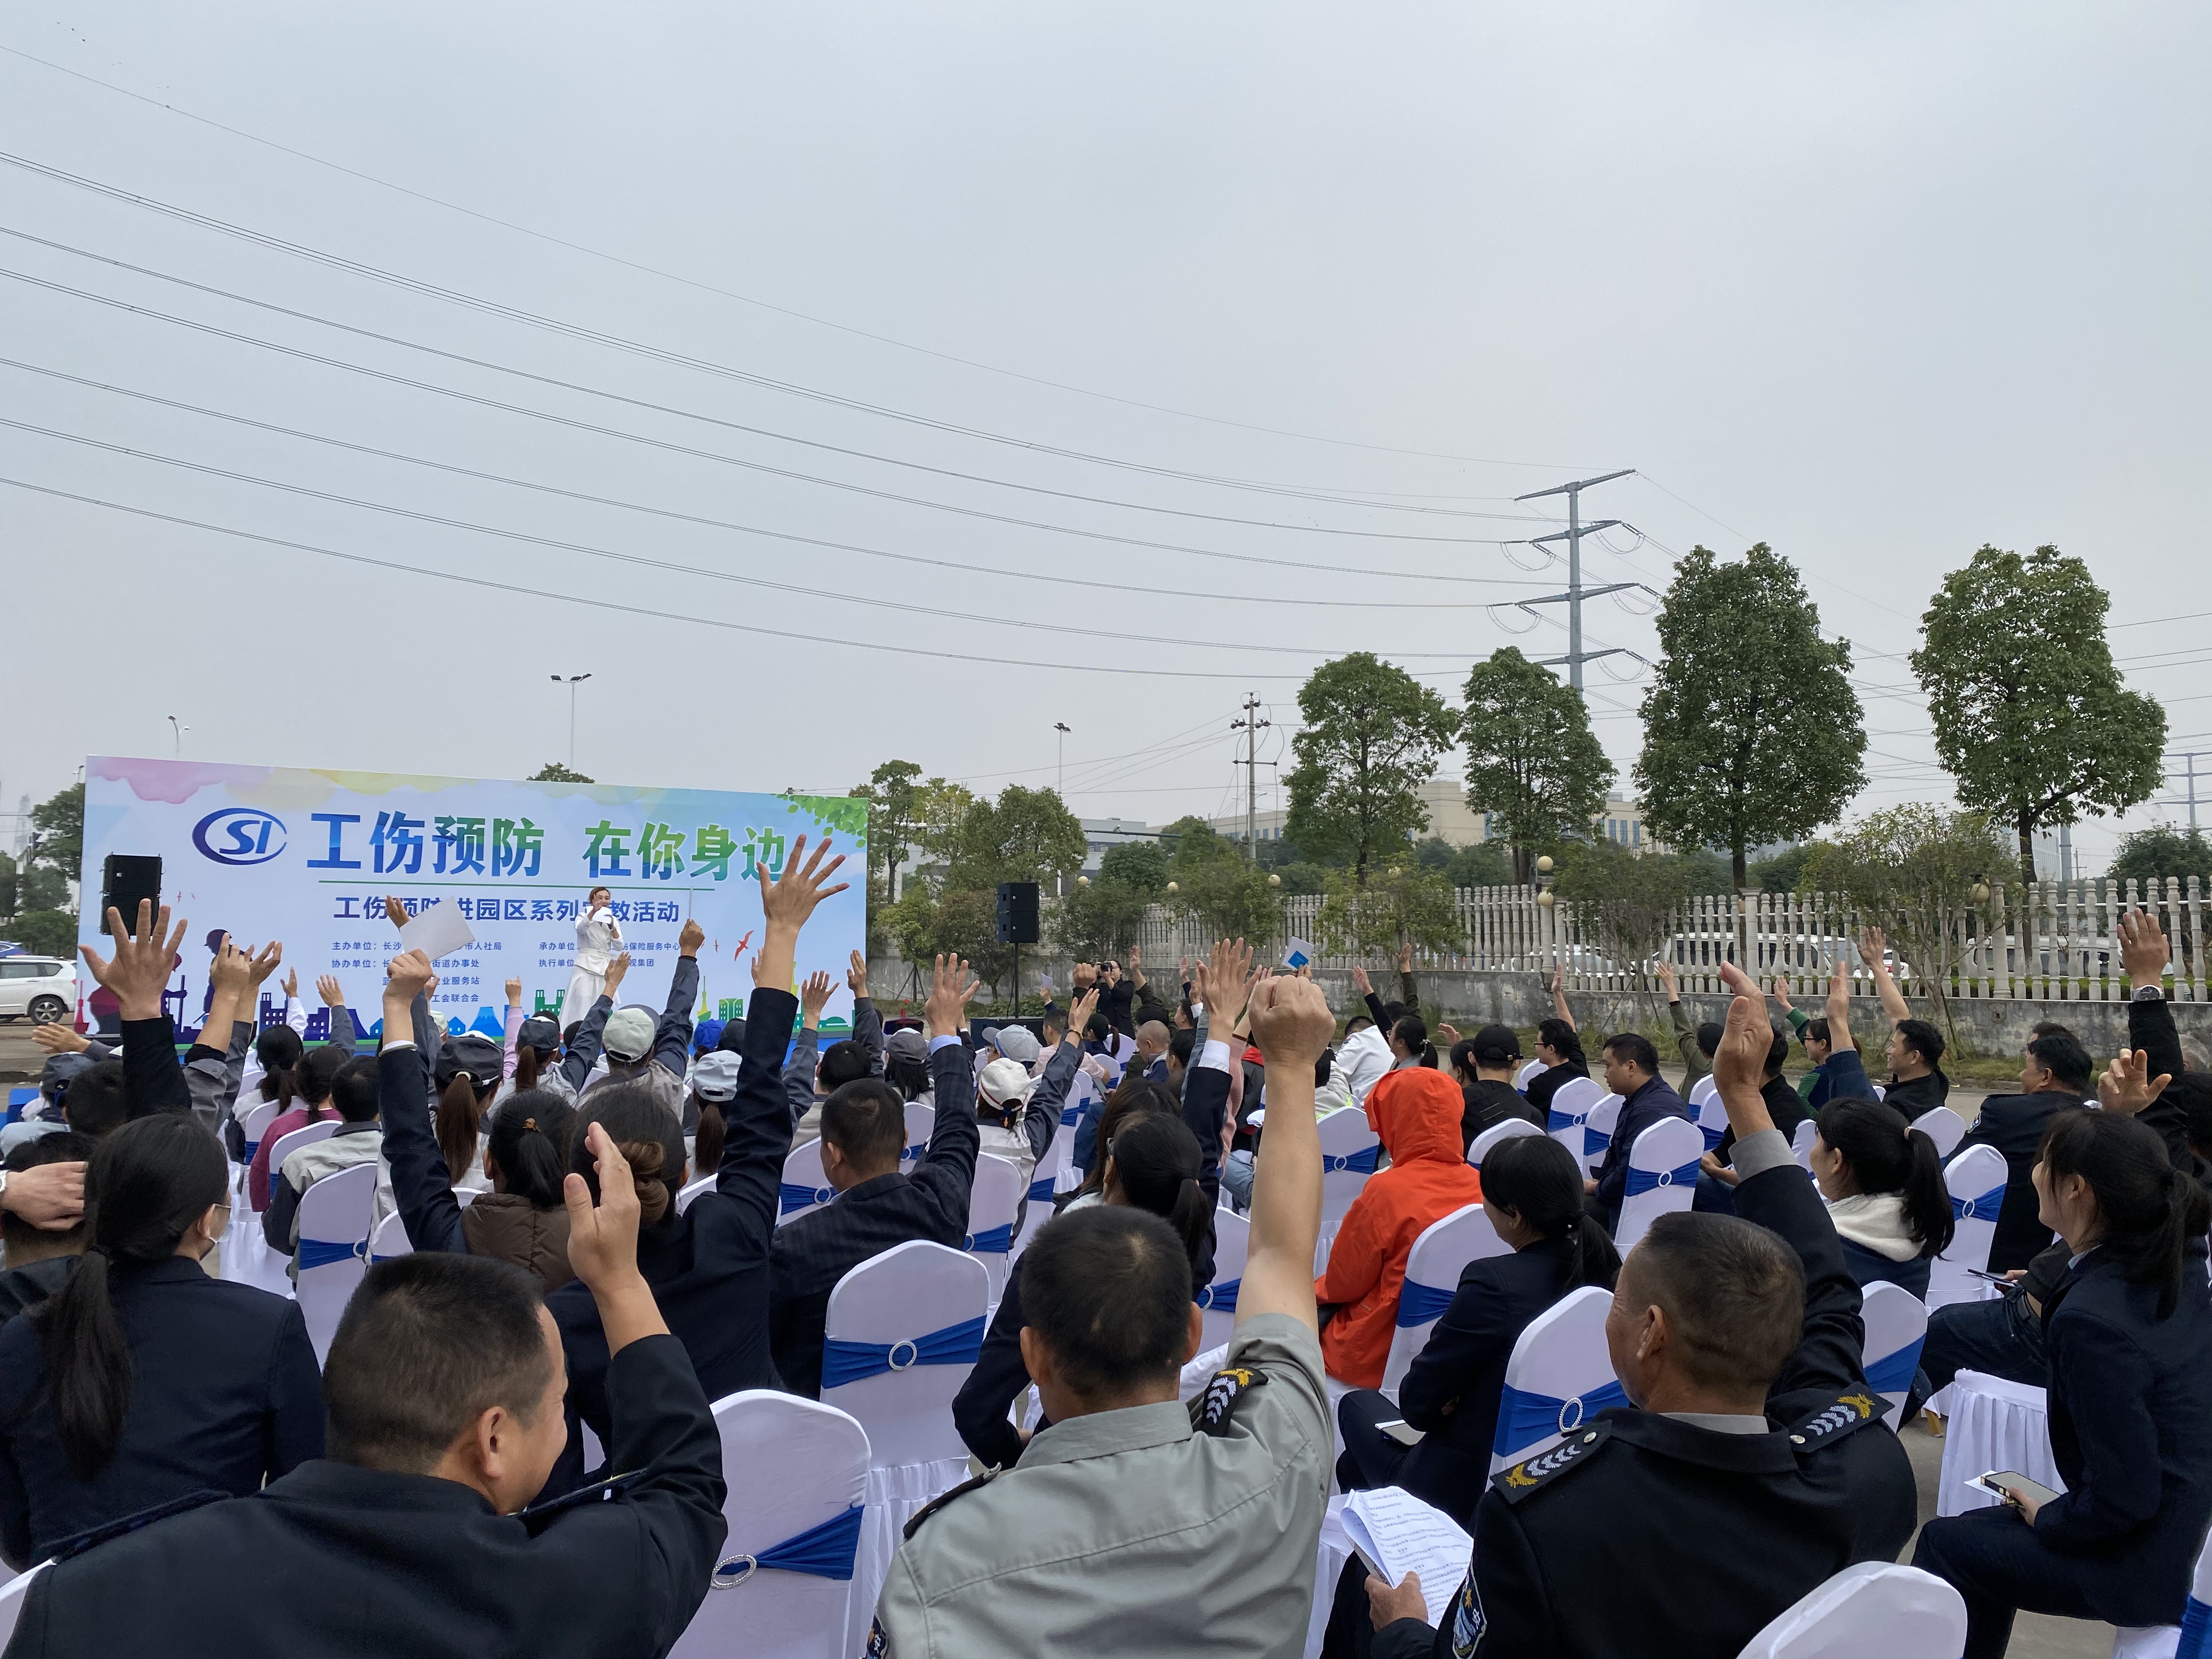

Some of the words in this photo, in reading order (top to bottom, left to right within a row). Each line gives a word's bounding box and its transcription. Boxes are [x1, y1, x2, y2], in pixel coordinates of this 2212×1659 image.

[307, 810, 544, 877] 工伤预防
[582, 820, 785, 881] 在你身边
